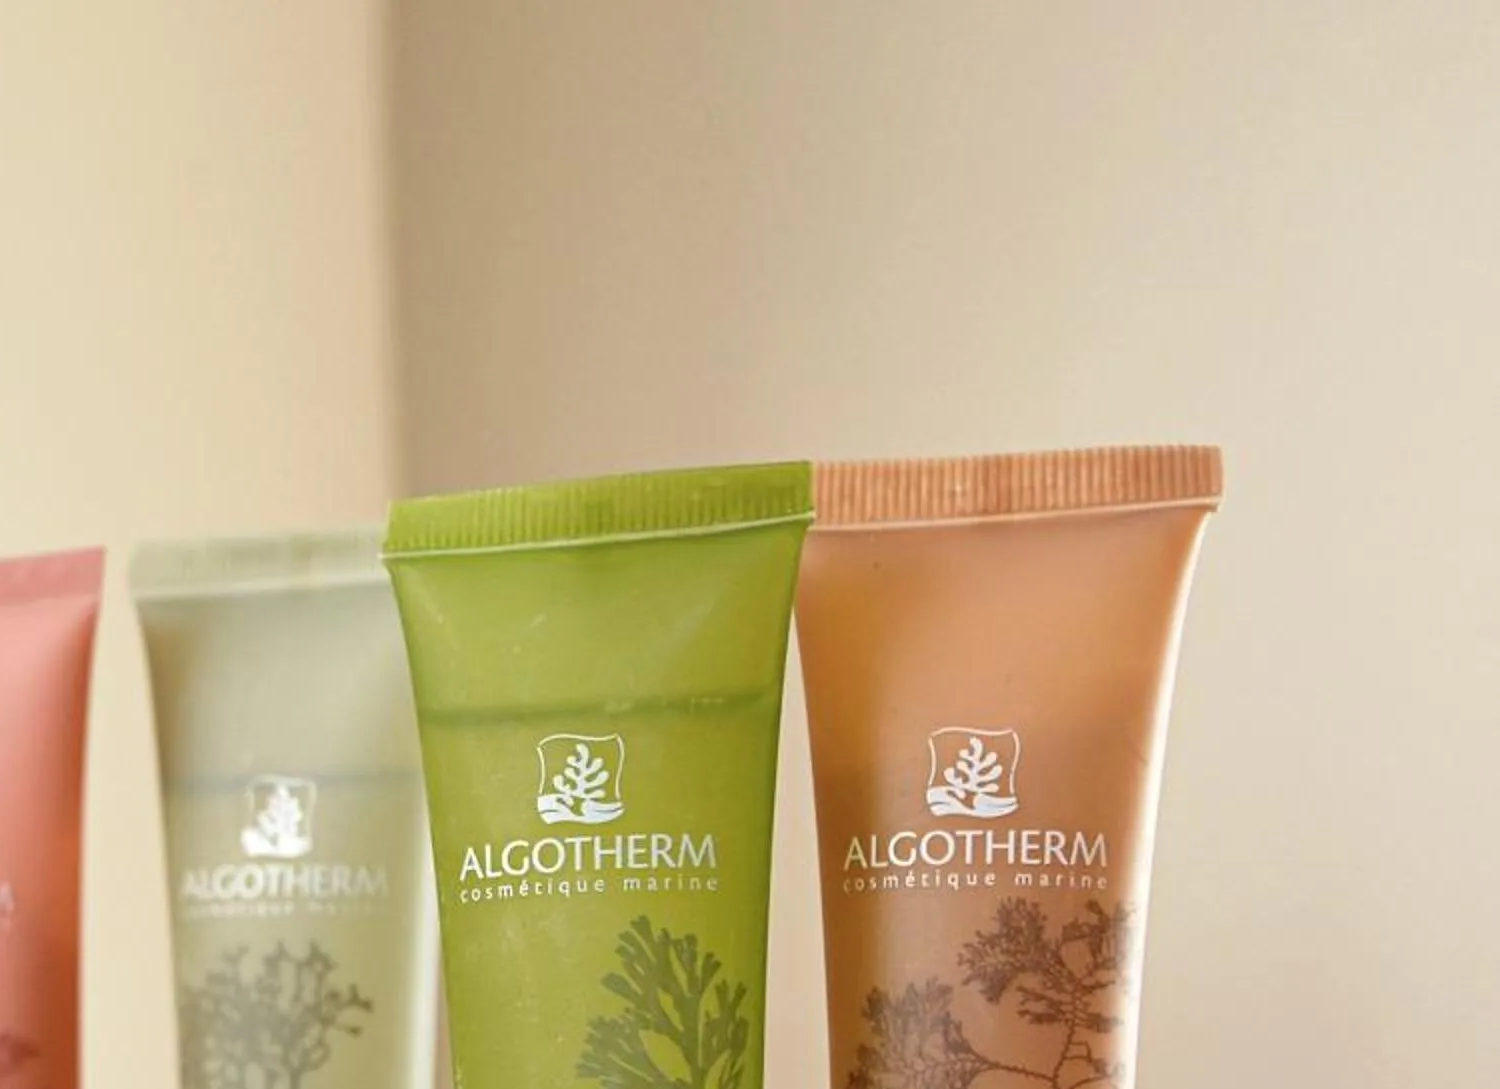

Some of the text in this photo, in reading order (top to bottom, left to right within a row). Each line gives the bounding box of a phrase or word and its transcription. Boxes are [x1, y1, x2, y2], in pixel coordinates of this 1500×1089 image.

[460, 833, 718, 882] ALGOTHERM
[843, 829, 1108, 871] ALGOTHERM
[182, 862, 390, 900] ALGOTHERM
[460, 873, 719, 903] cosmétique marine
[843, 869, 1108, 893] cosmétique marine
